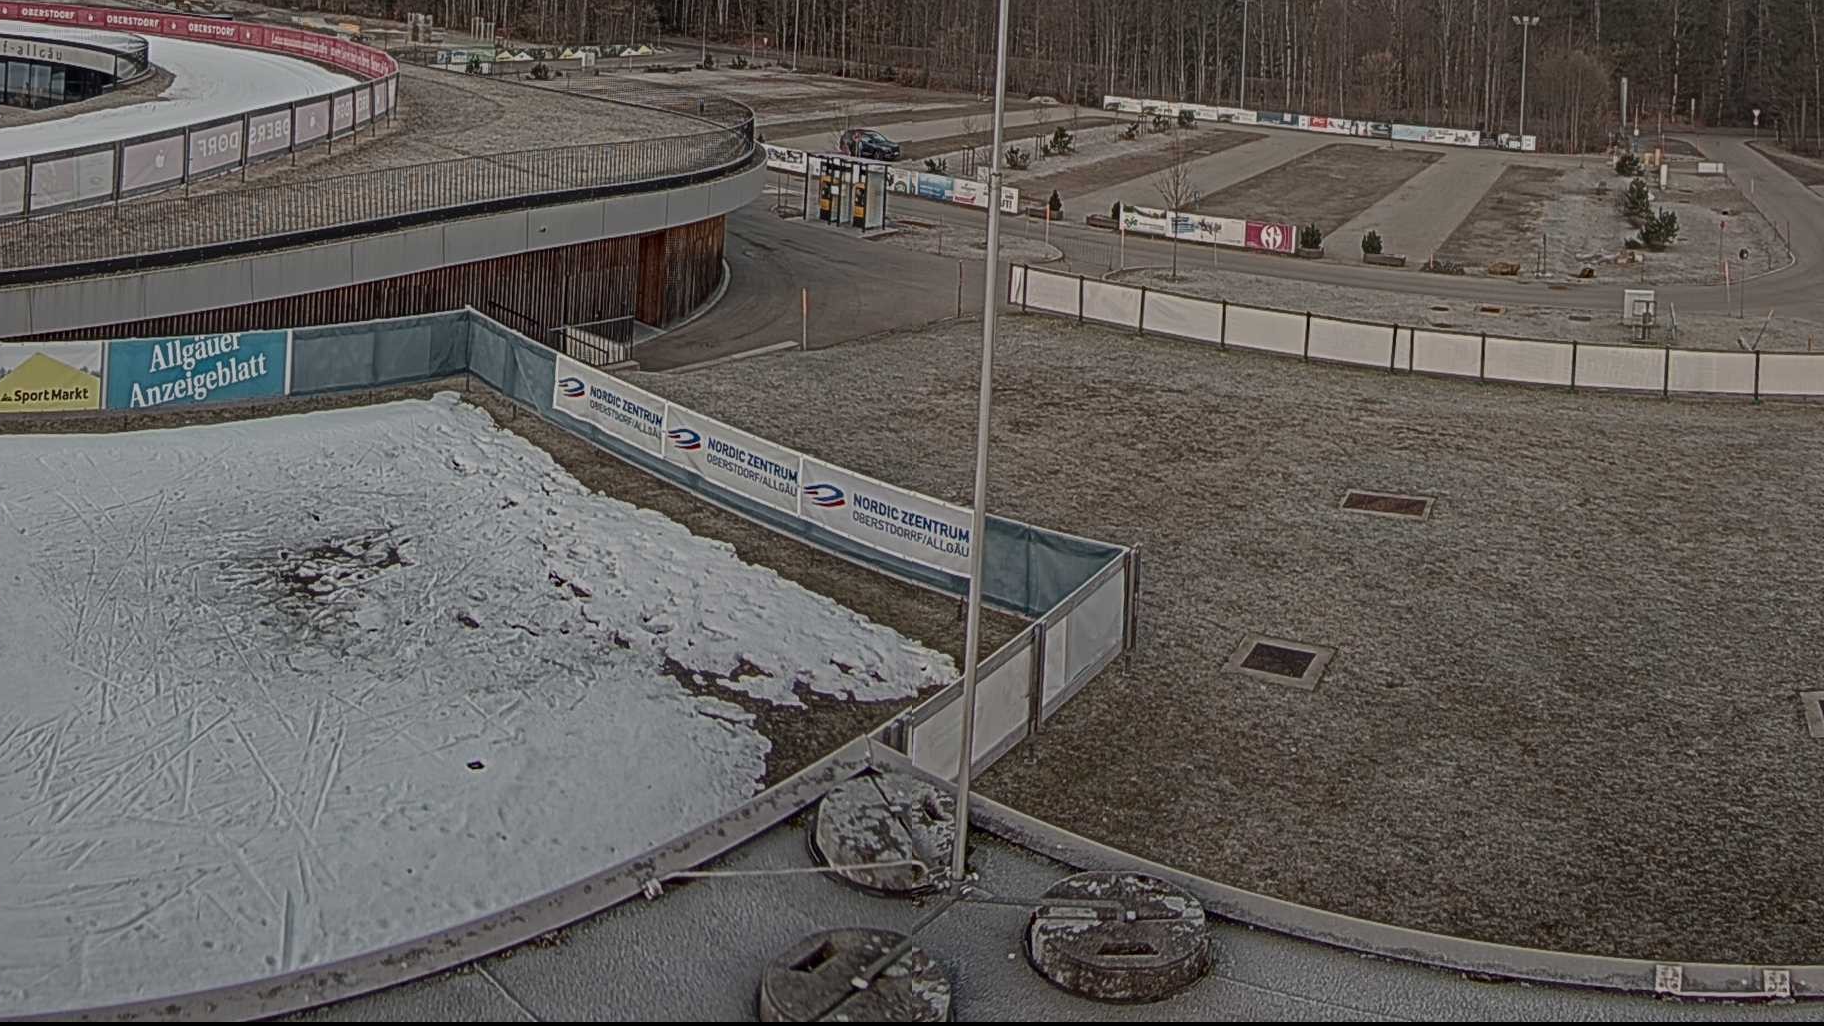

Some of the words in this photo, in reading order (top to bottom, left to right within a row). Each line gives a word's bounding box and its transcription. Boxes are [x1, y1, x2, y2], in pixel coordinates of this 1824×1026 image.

[21, 7, 75, 21] OBERSTDORF
[106, 15, 159, 28] OBERSTDORF
[188, 22, 235, 37] OBERSTDORF
[149, 333, 241, 373] Allgäuer
[130, 352, 267, 409] Anzeigeblatt
[589, 385, 622, 408] NORDIC
[622, 399, 663, 428] ZENTRUM
[707, 436, 746, 463] NORDIC
[747, 452, 799, 484] ZENTRUM
[853, 493, 899, 521] NORDIC
